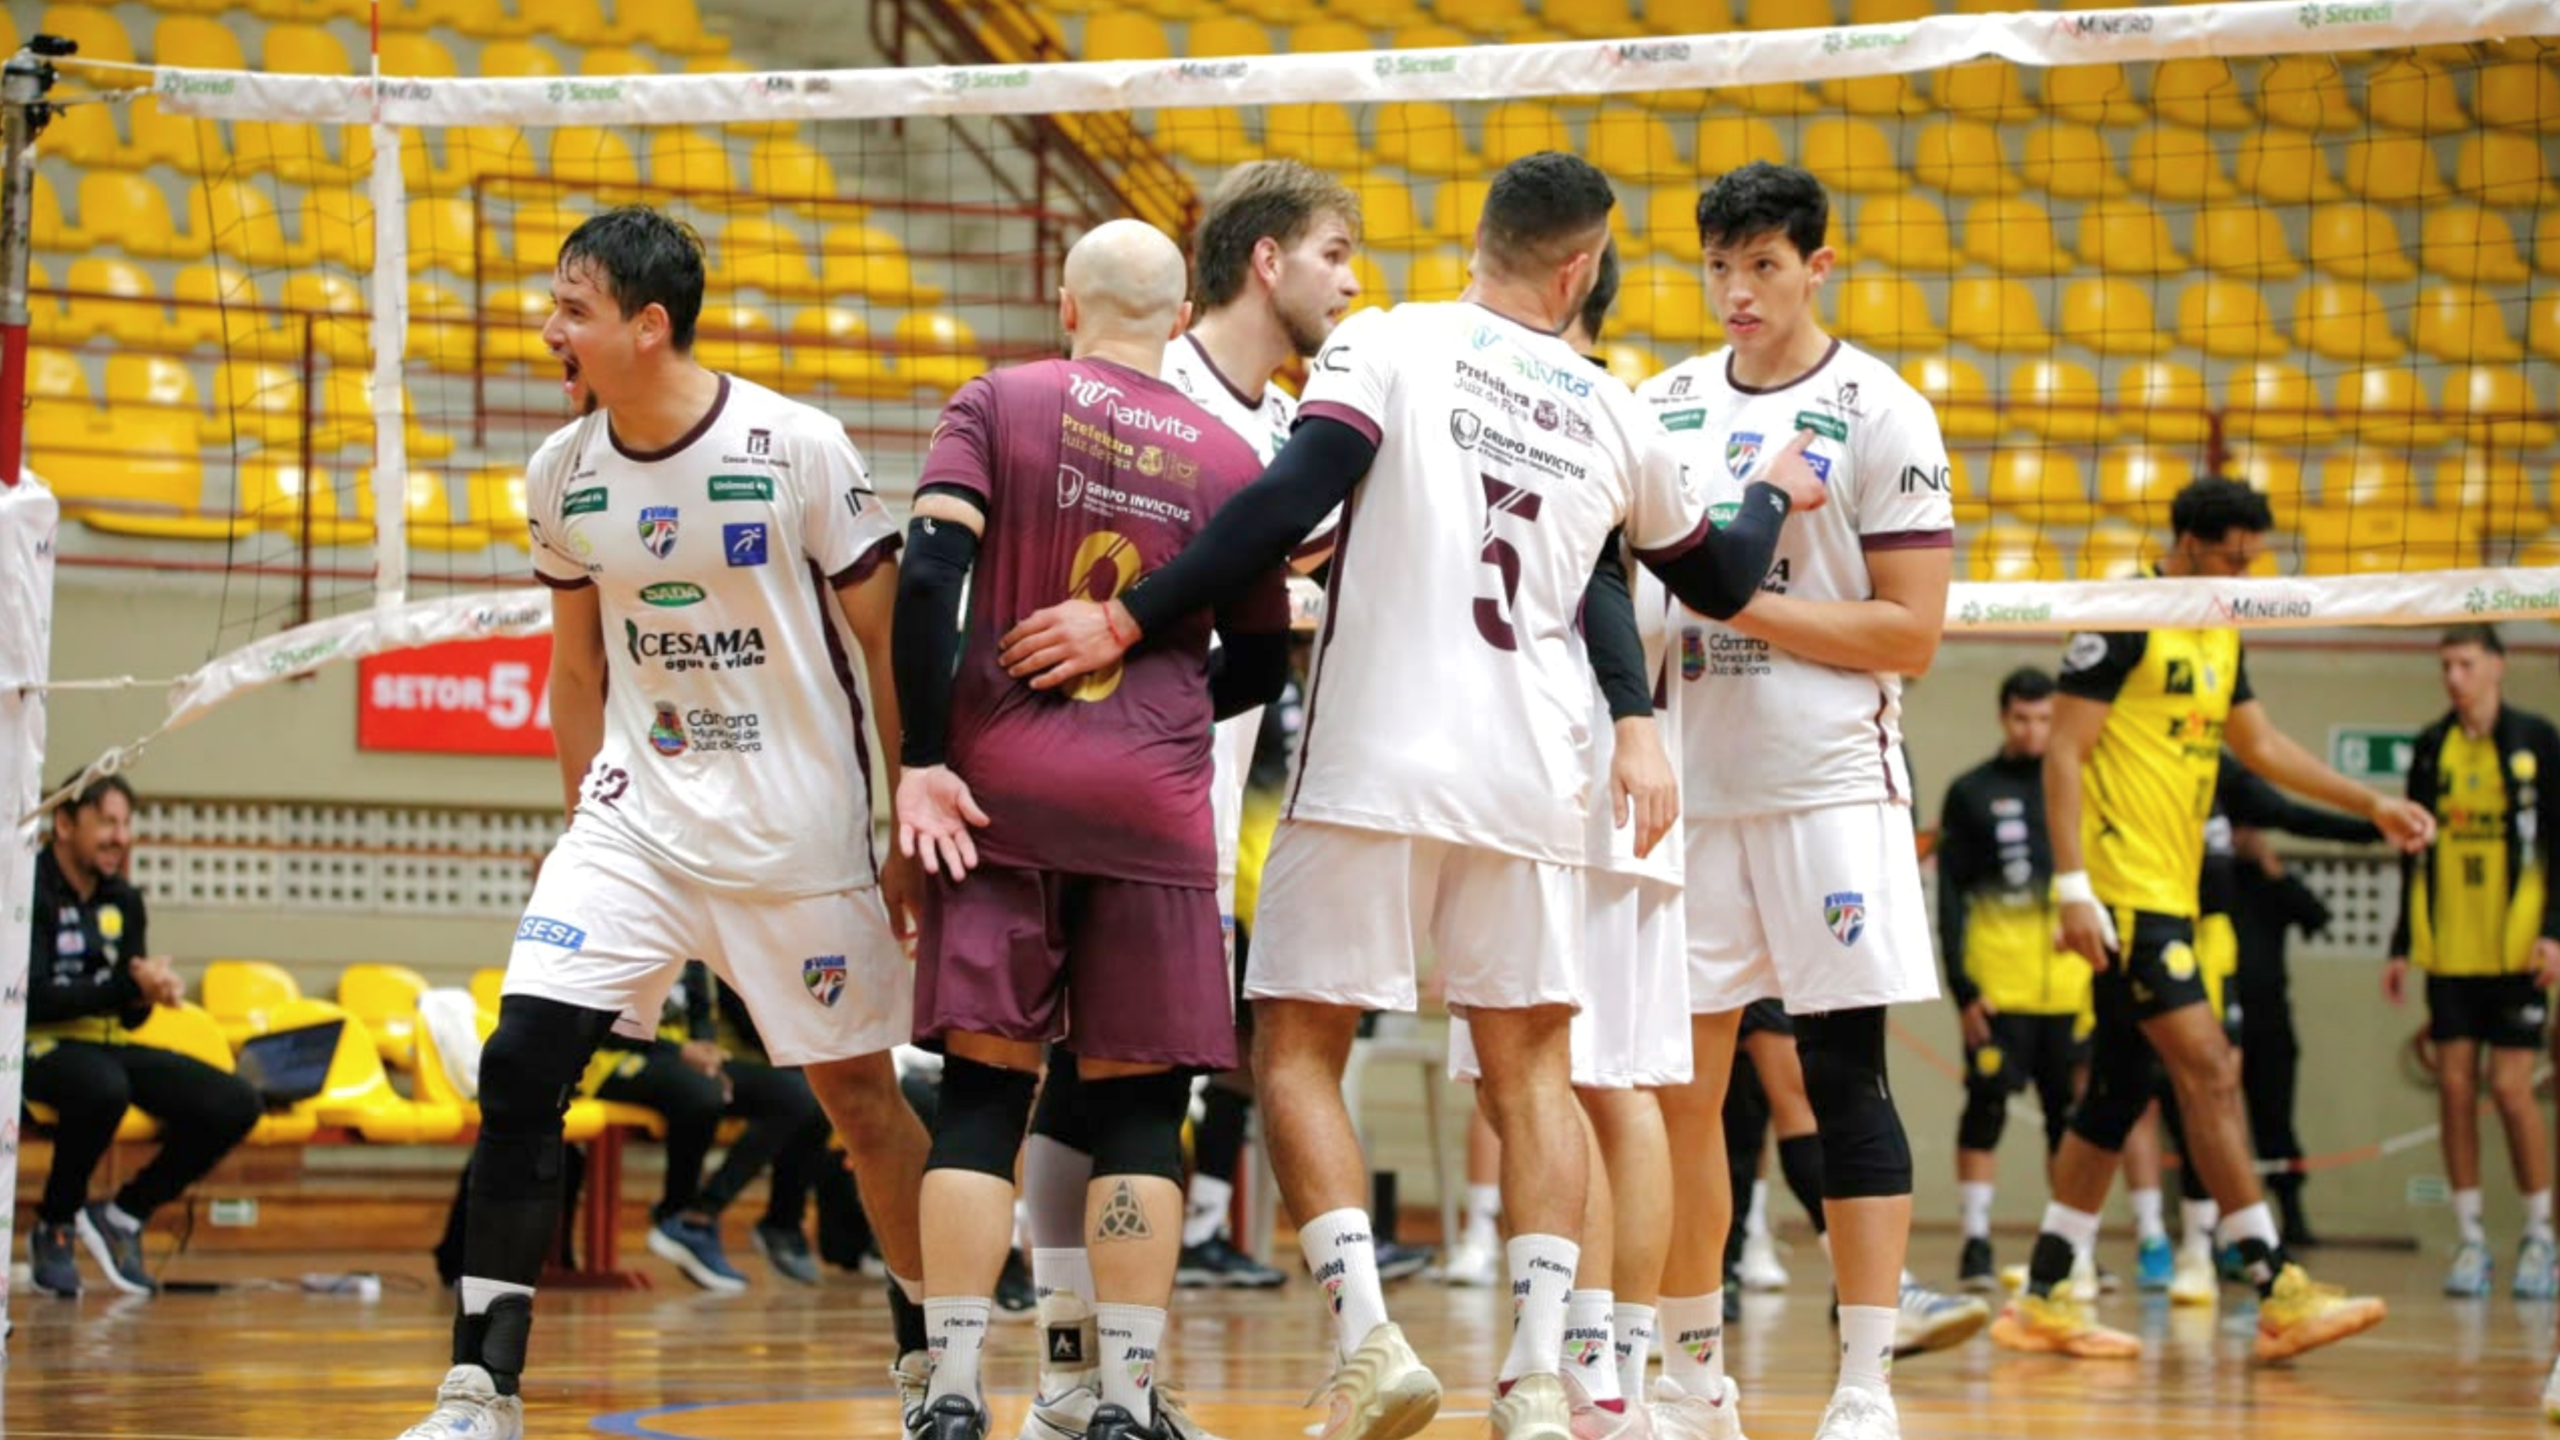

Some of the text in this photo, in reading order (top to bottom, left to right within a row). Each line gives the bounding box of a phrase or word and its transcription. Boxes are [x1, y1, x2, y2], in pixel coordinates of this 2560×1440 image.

[2324, 3, 2391, 24] Sicredi
[181, 77, 235, 96] Sicredi
[1062, 412, 1134, 456] Prefeitura
[1106, 399, 1198, 442] nativita
[1482, 426, 1587, 480] GRUPO INVICTUS
[1085, 480, 1127, 504] GRUPO
[1130, 493, 1192, 523] INVICTUS
[1472, 472, 1543, 652] 5
[643, 585, 702, 601] SADA
[2230, 598, 2312, 617] MINEIRO
[1984, 602, 2051, 622] Sicredi
[639, 627, 765, 658] CESAMA
[725, 652, 765, 670] vida
[371, 673, 486, 713] SETOR
[520, 918, 579, 946] SESI
